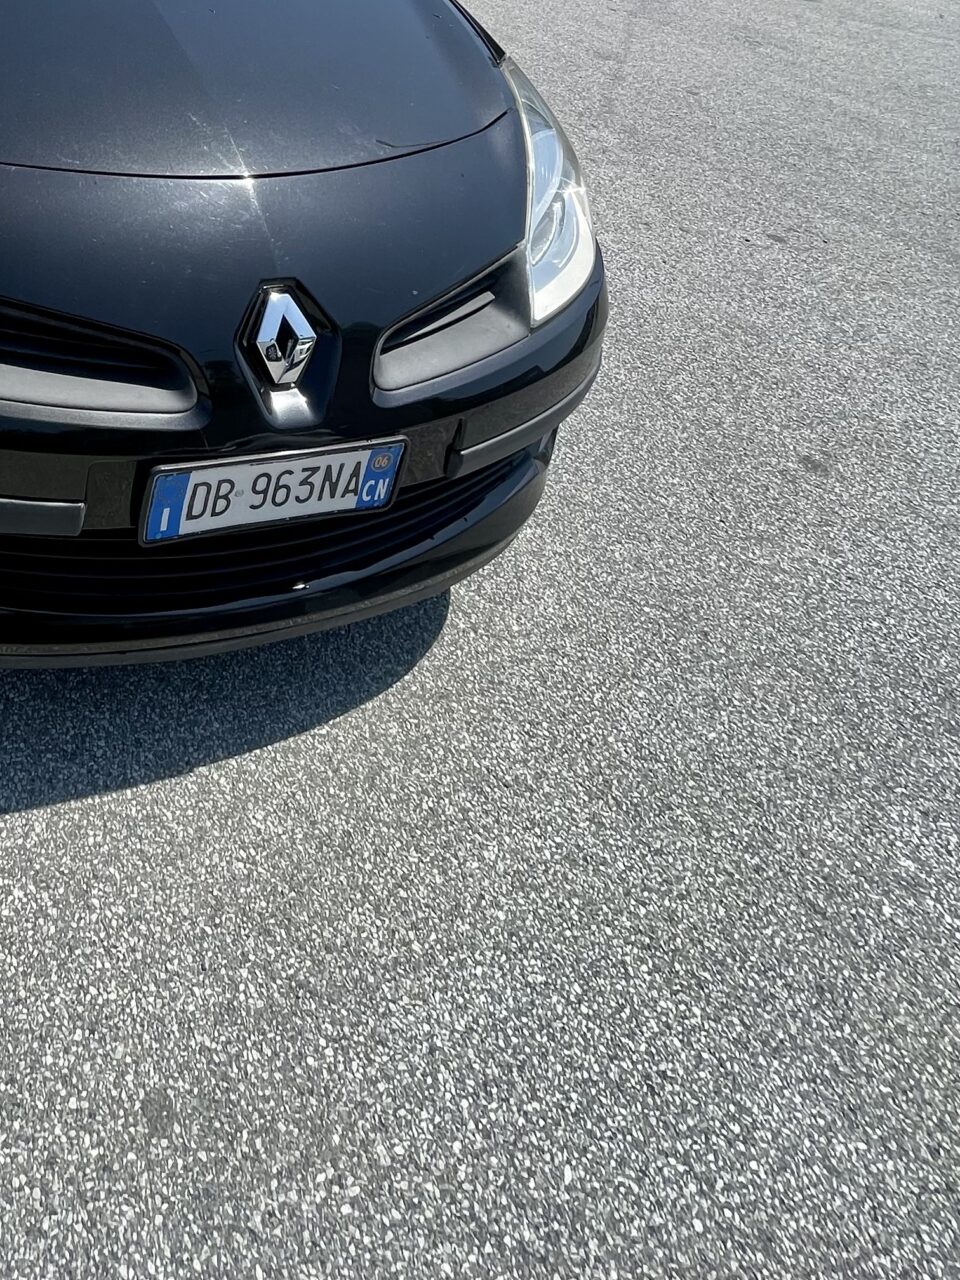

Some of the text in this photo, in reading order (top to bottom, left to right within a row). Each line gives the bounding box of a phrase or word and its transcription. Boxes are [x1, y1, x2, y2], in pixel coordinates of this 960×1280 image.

[375, 456, 389, 469] 06
[186, 461, 362, 521] DB 963NA
[362, 478, 389, 502] CN
[160, 508, 170, 532] I
